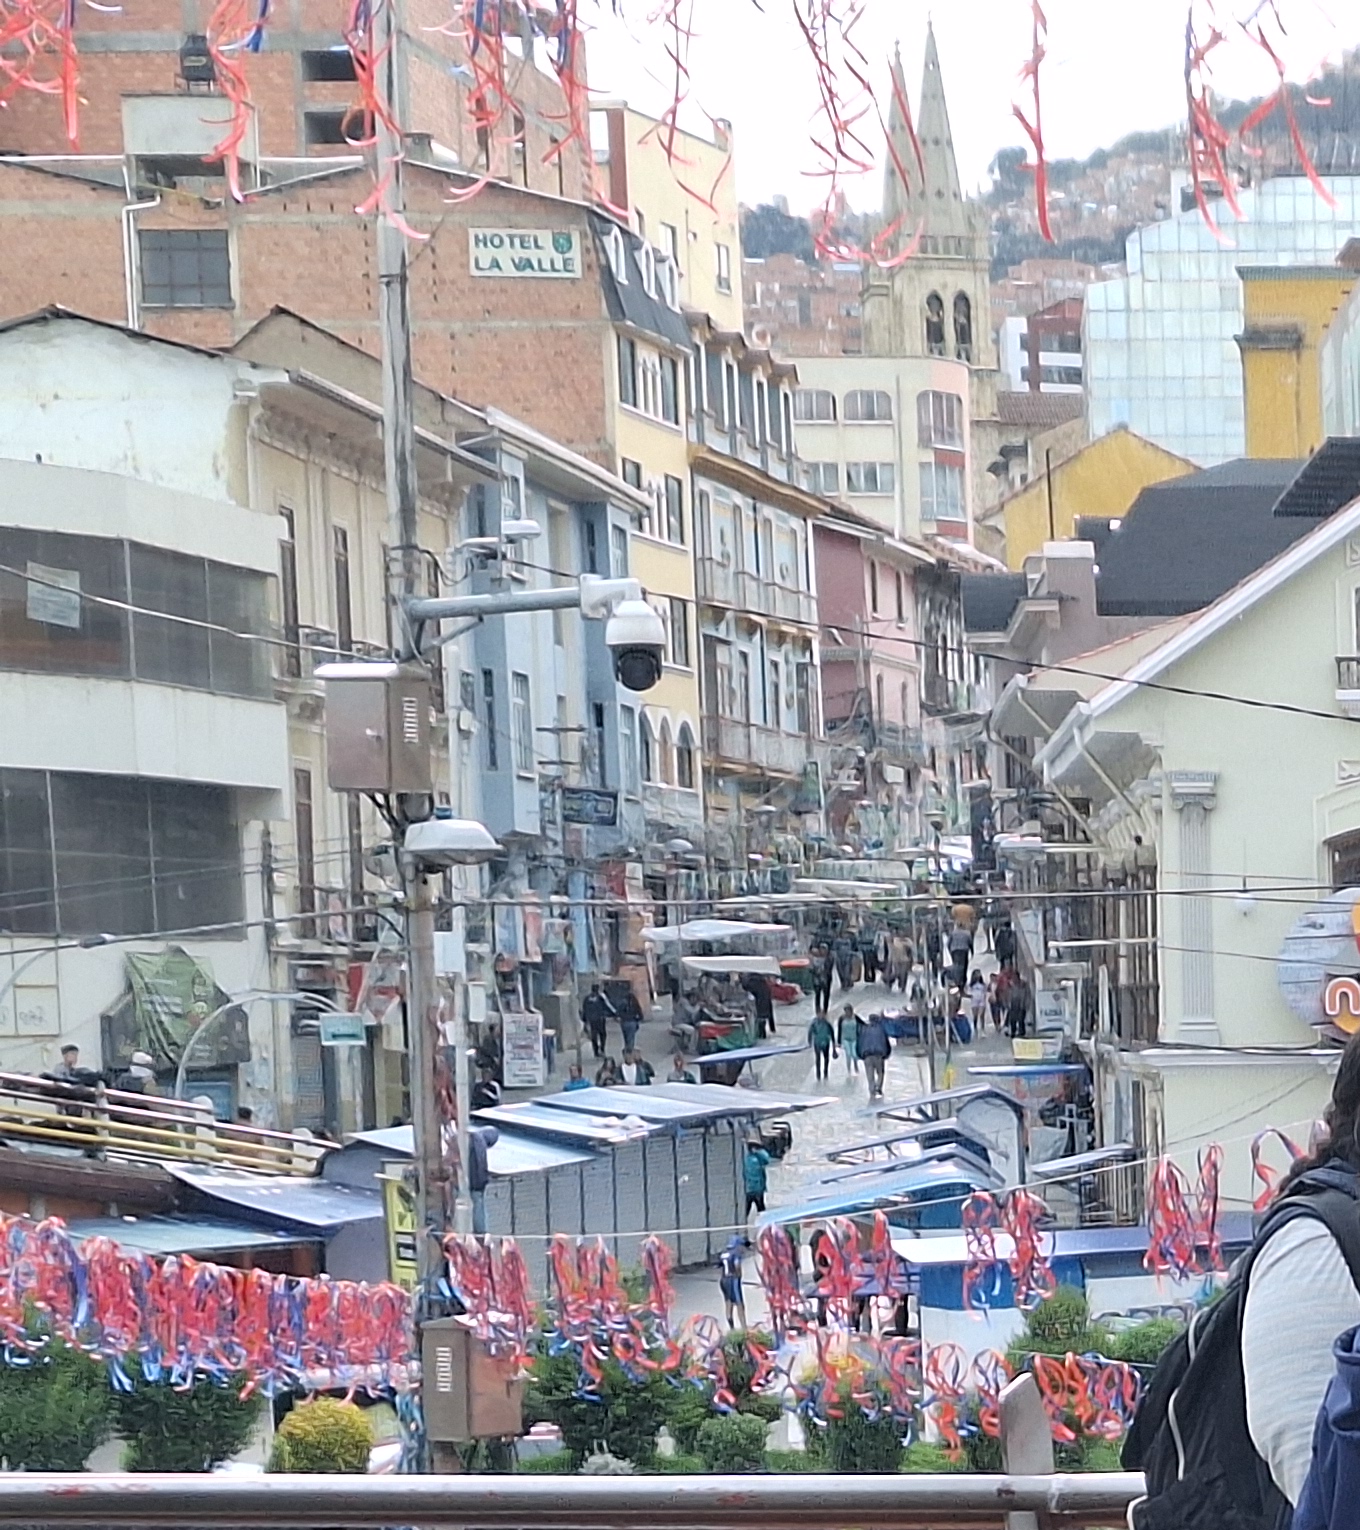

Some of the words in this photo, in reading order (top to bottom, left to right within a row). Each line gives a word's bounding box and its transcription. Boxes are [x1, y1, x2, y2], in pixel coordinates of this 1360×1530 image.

[474, 233, 544, 250] HOTEL
[474, 255, 502, 273] LA
[511, 256, 575, 273] VALLE
